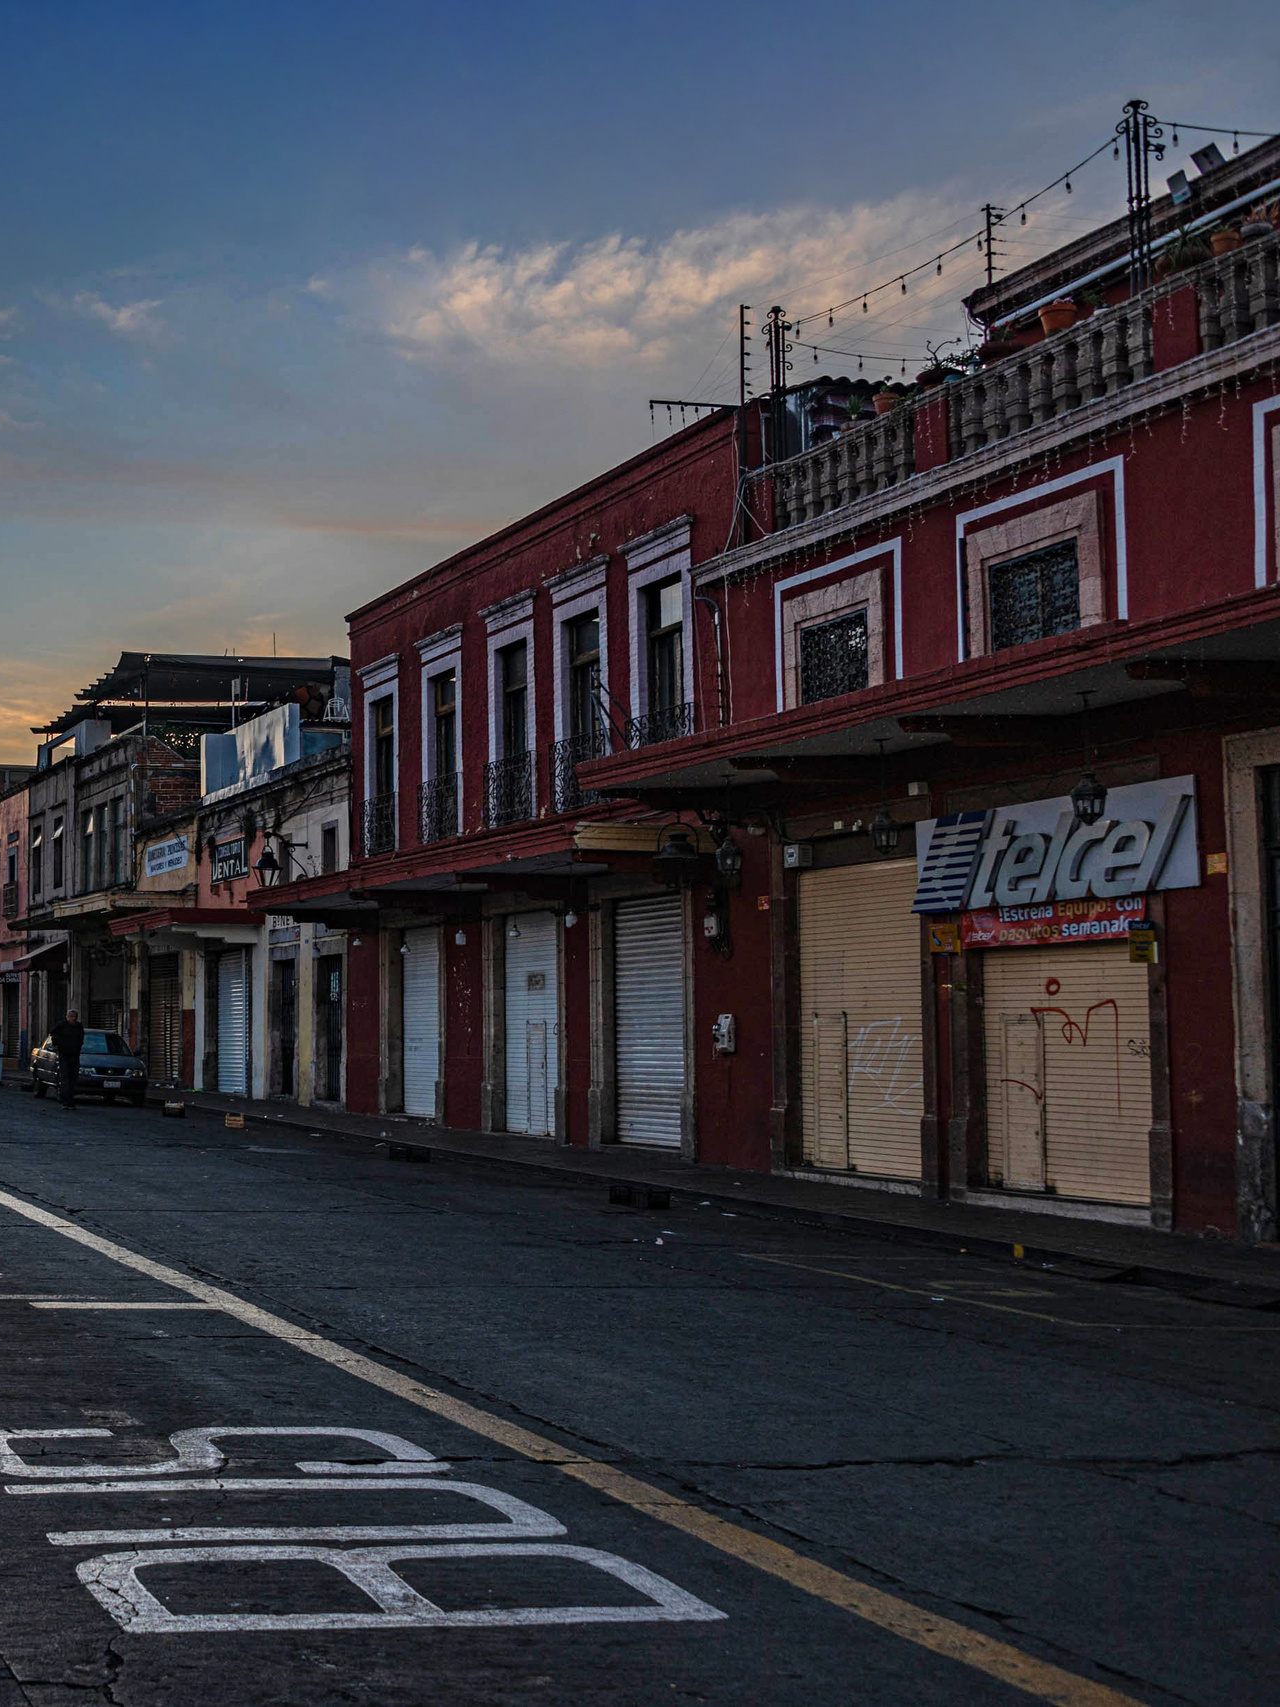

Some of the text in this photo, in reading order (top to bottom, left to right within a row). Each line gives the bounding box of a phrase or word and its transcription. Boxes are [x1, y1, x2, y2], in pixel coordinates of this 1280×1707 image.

[212, 841, 248, 880] DENTAL
[969, 794, 1192, 910] telcel
[1116, 897, 1142, 911] con
[998, 922, 1060, 942] paguitos
